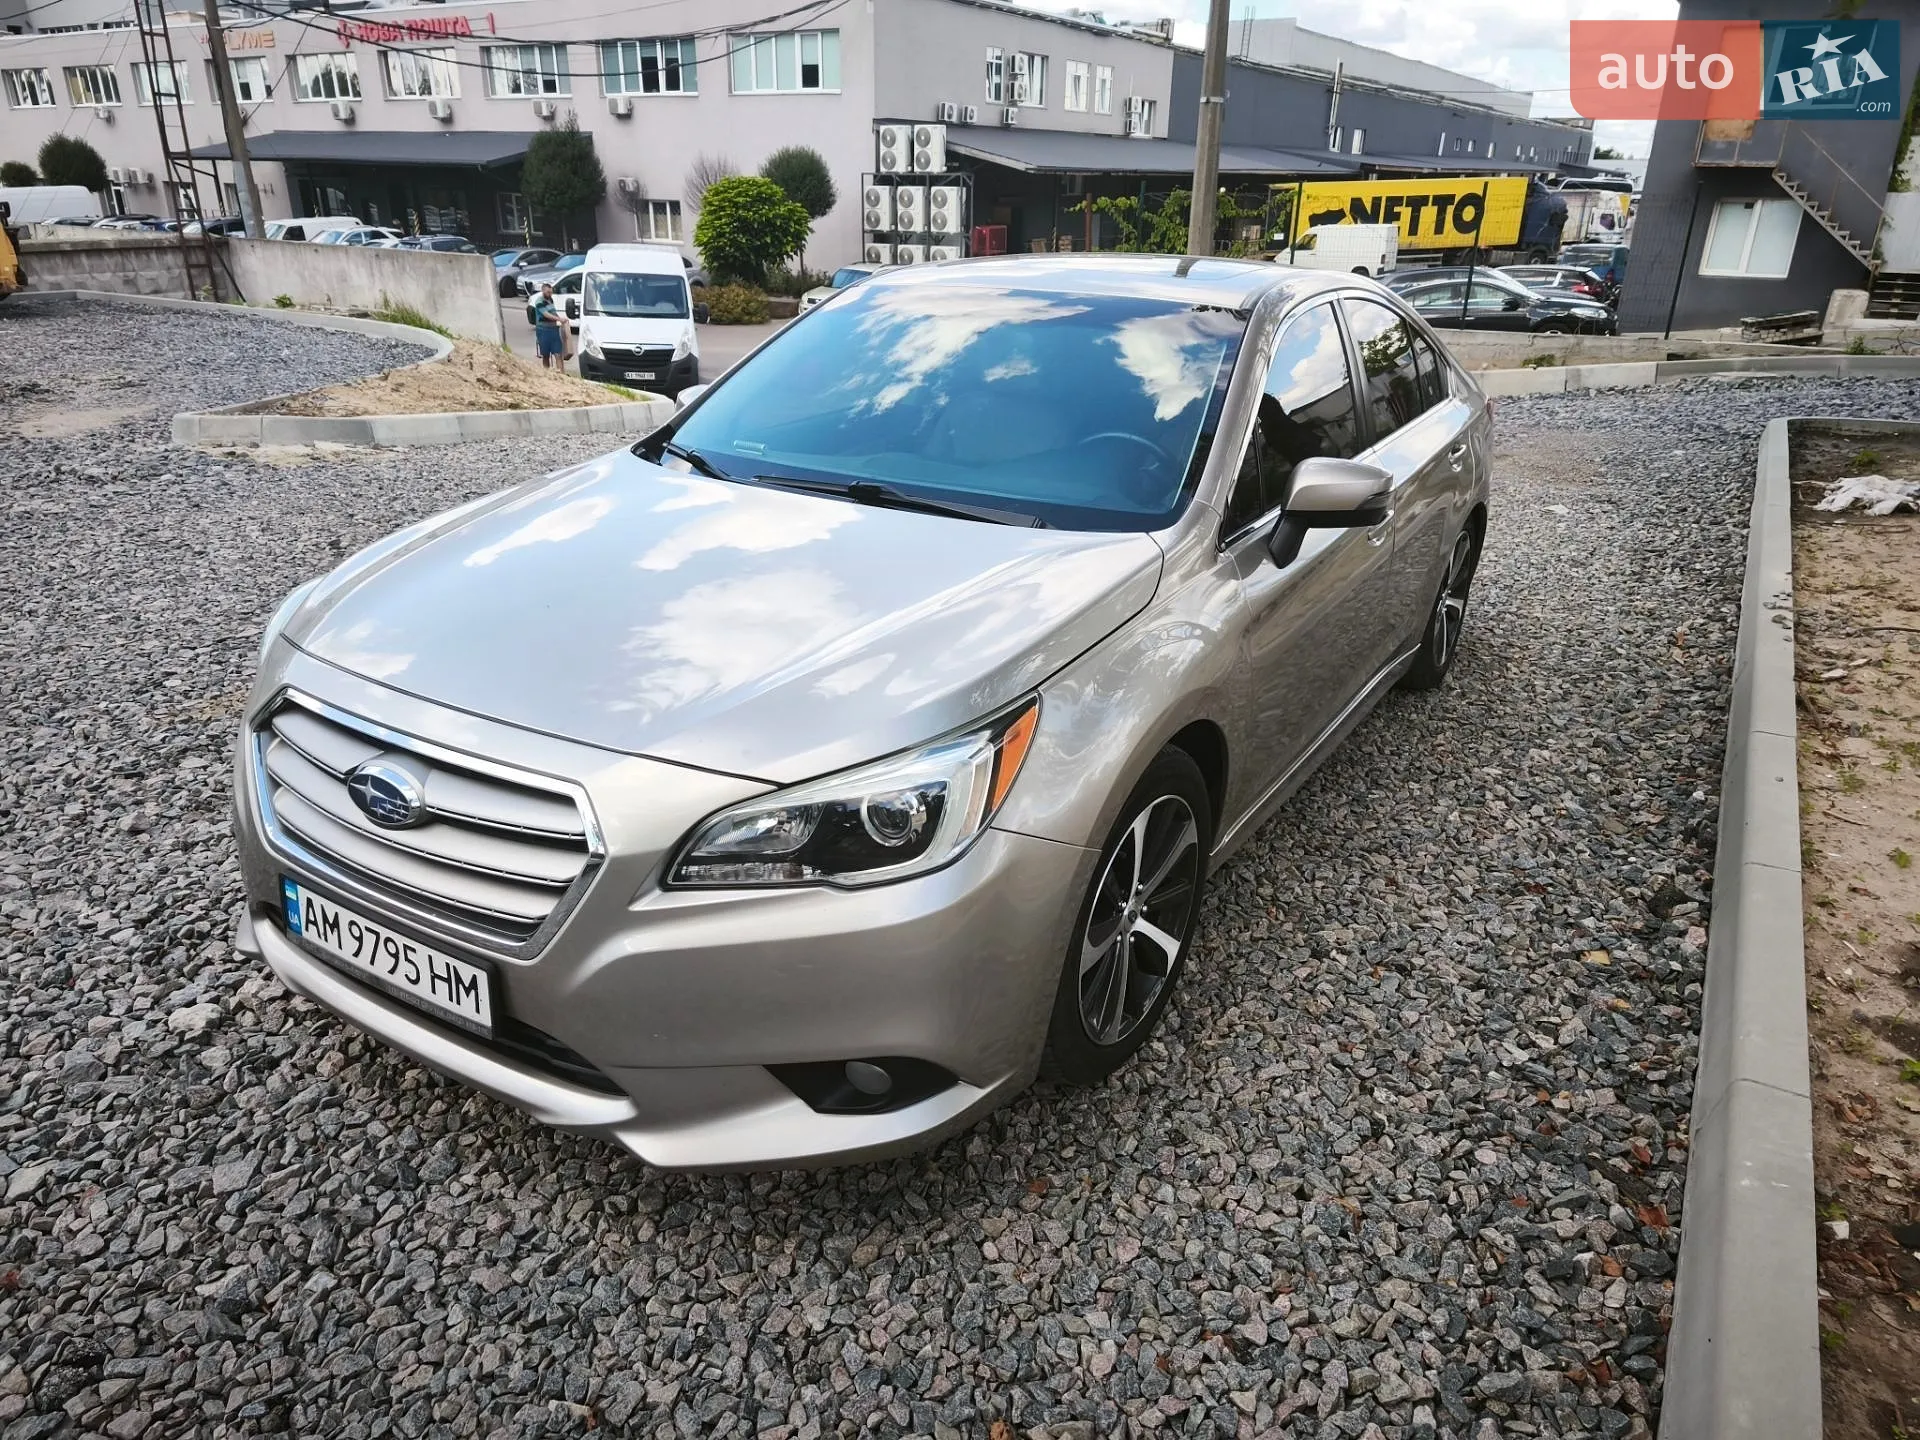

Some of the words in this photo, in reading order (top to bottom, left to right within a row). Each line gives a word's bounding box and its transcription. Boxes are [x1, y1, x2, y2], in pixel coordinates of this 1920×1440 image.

[1350, 192, 1485, 237] NETTO
[288, 911, 300, 927] UA
[304, 896, 342, 950] AM
[347, 919, 421, 985] 9795
[427, 953, 481, 1015] HM
